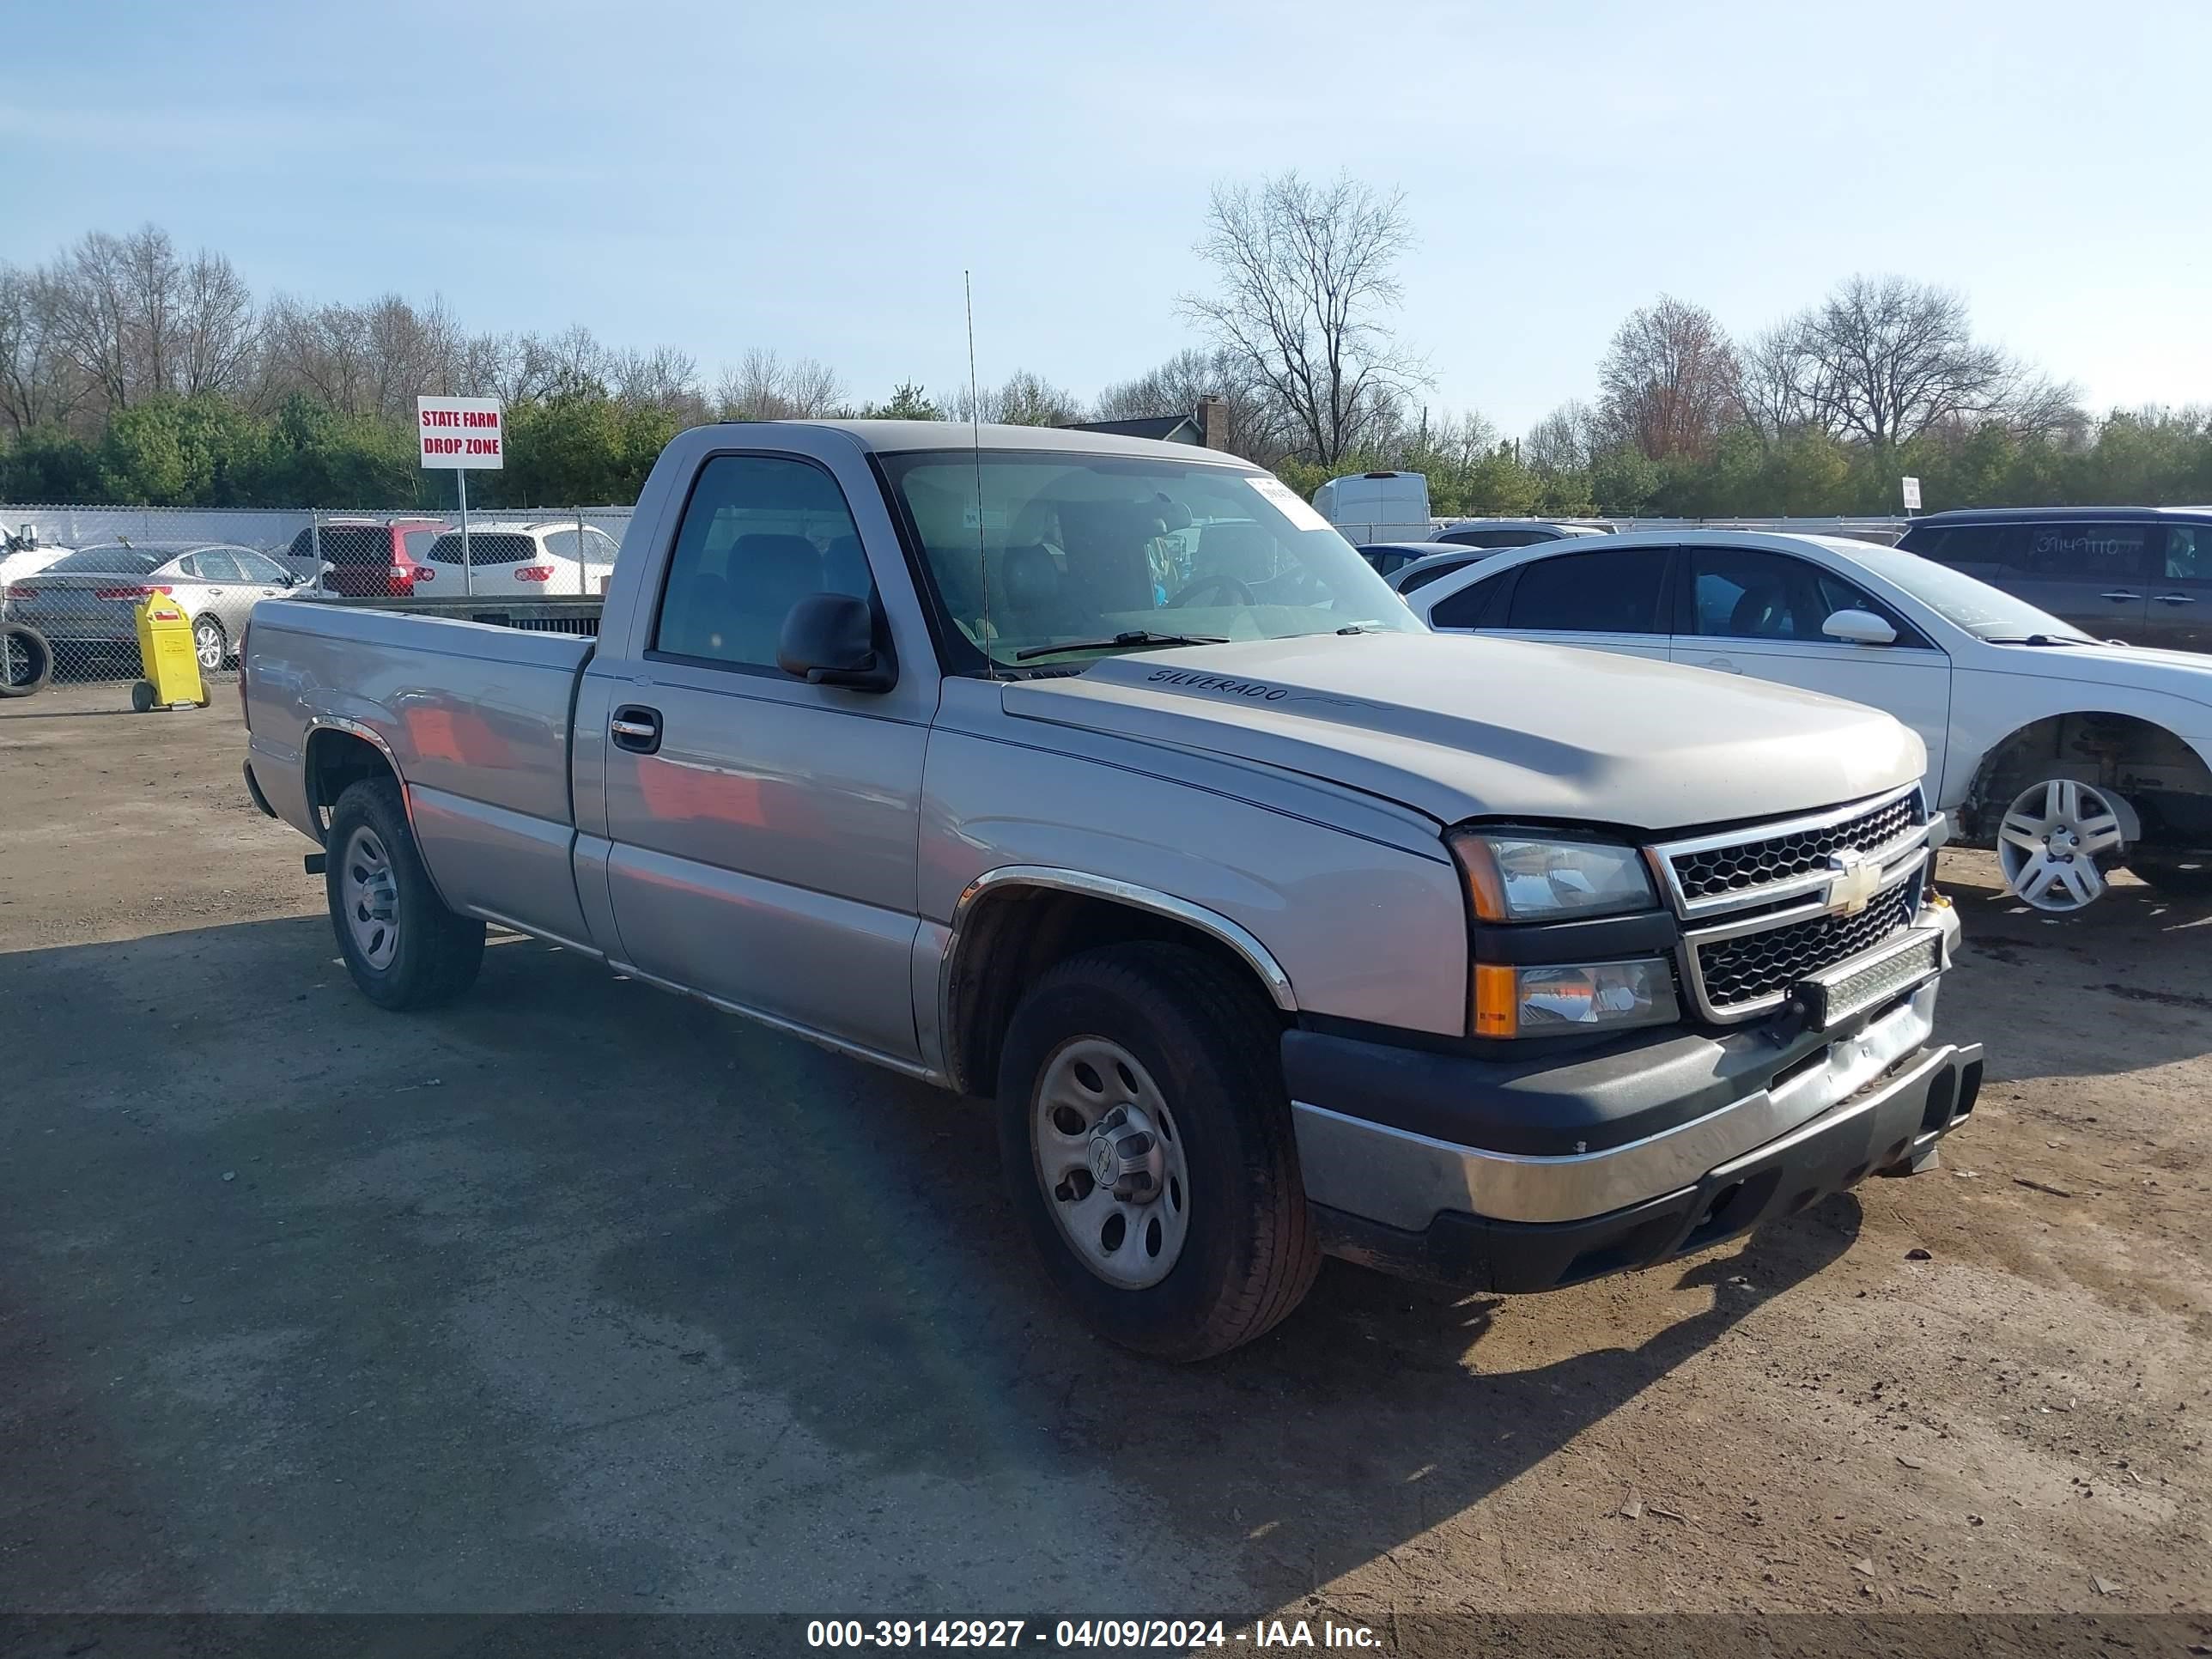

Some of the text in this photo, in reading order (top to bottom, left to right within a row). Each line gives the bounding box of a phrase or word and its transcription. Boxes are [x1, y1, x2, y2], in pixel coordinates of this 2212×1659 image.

[422, 410, 498, 428] STATE FARM
[423, 438, 500, 454] DROP ZONE
[1147, 670, 1288, 701] SILVERADO
